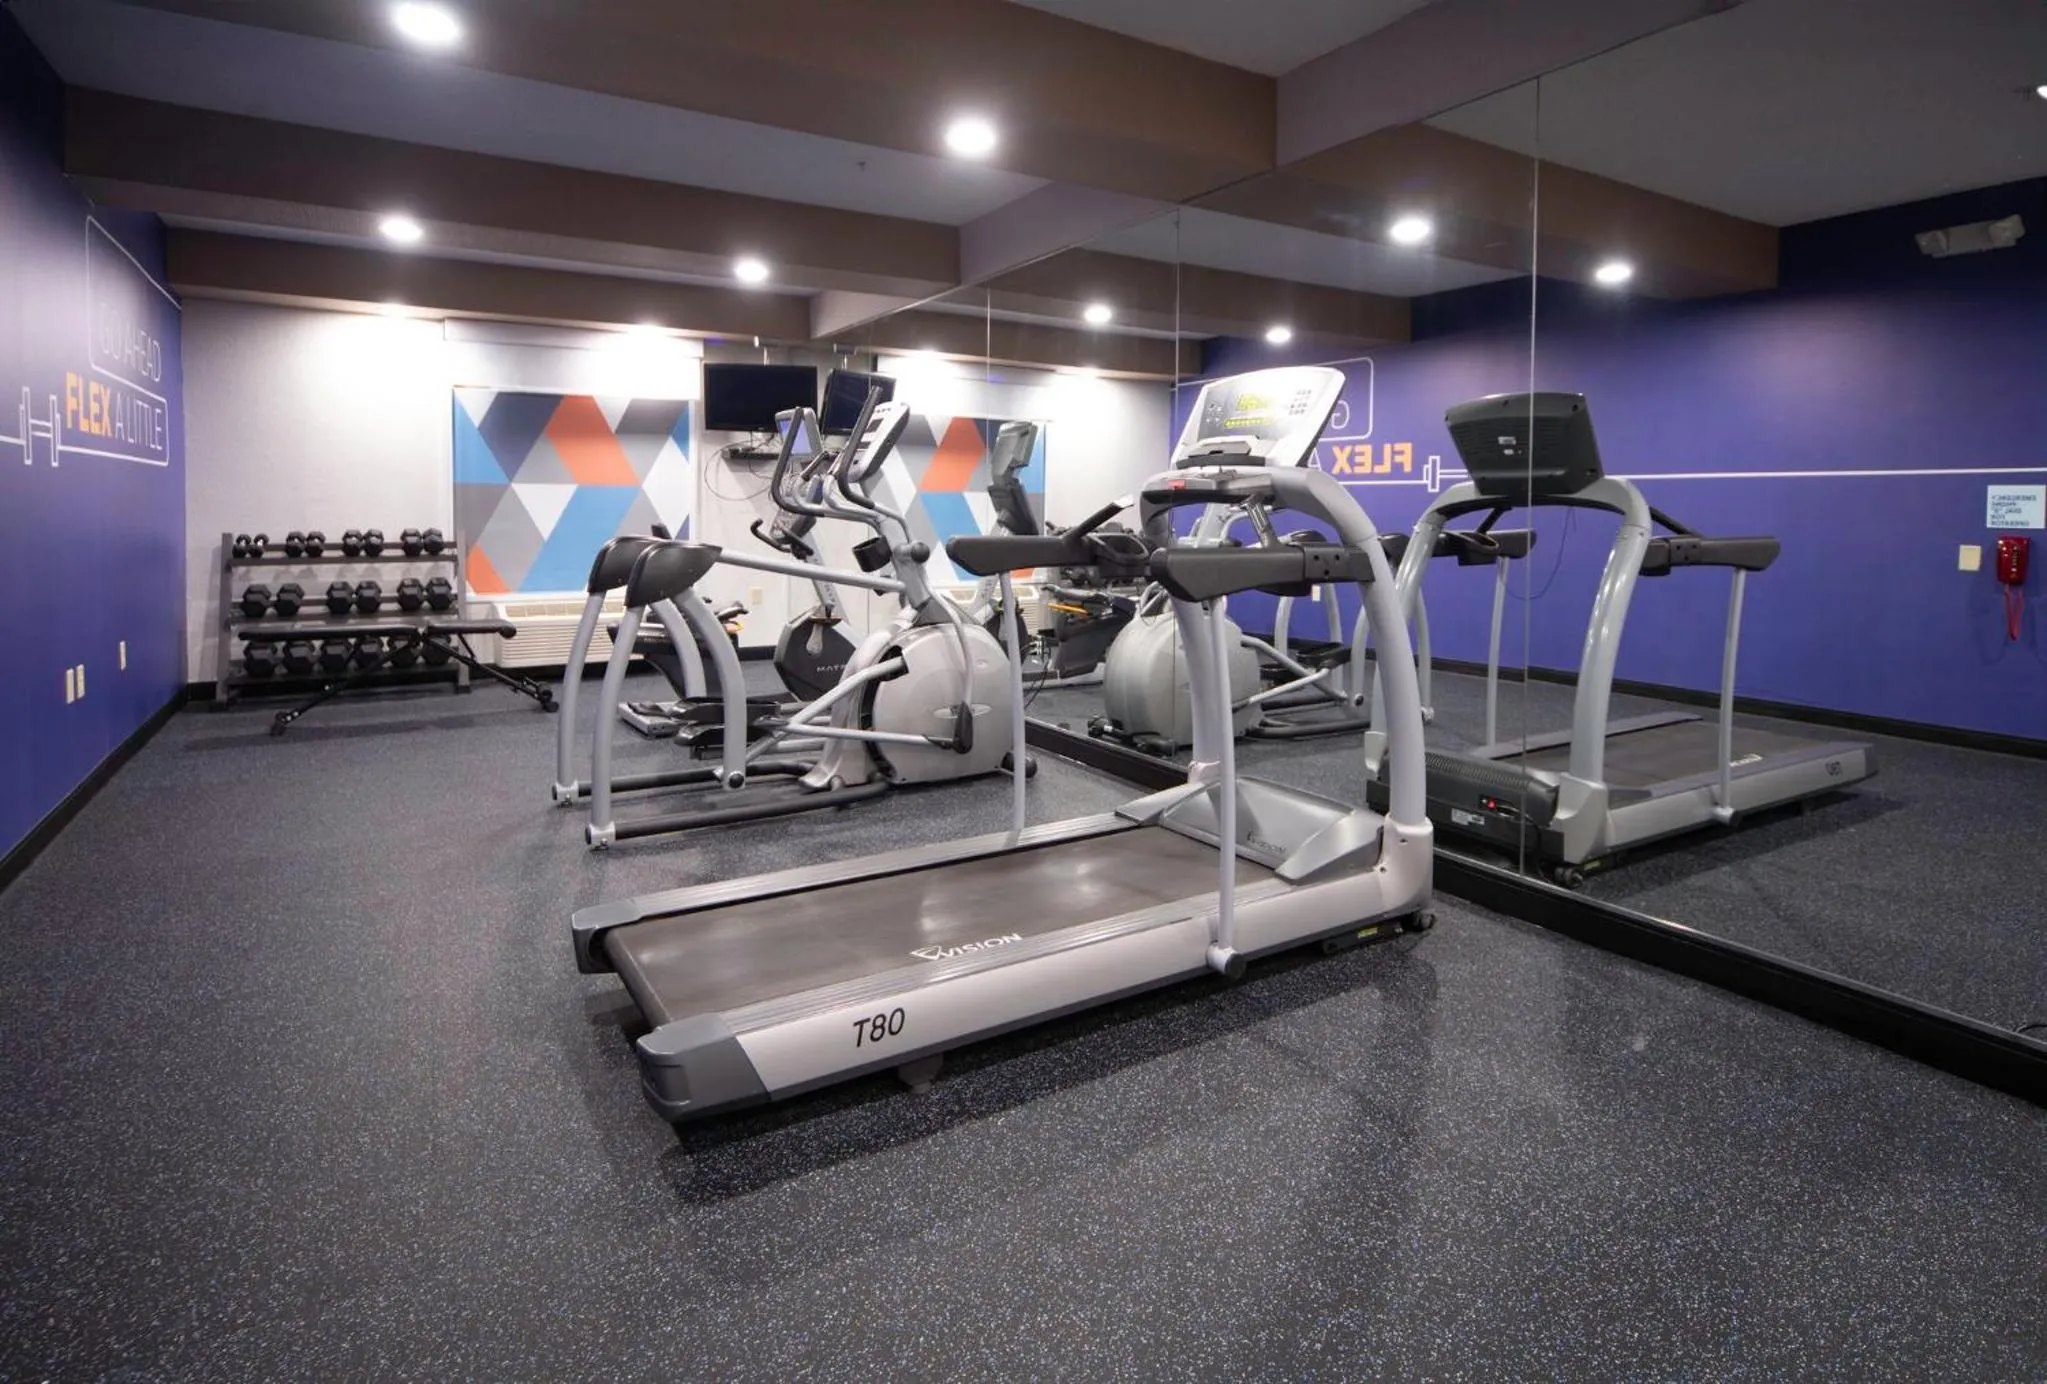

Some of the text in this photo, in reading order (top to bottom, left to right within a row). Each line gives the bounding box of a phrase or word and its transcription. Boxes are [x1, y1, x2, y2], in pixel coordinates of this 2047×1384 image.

[100, 303, 162, 383] GO AHEAD
[66, 371, 163, 451] FLEX A LITTLE
[940, 932, 1023, 959] VISION
[853, 1007, 906, 1048] T80
